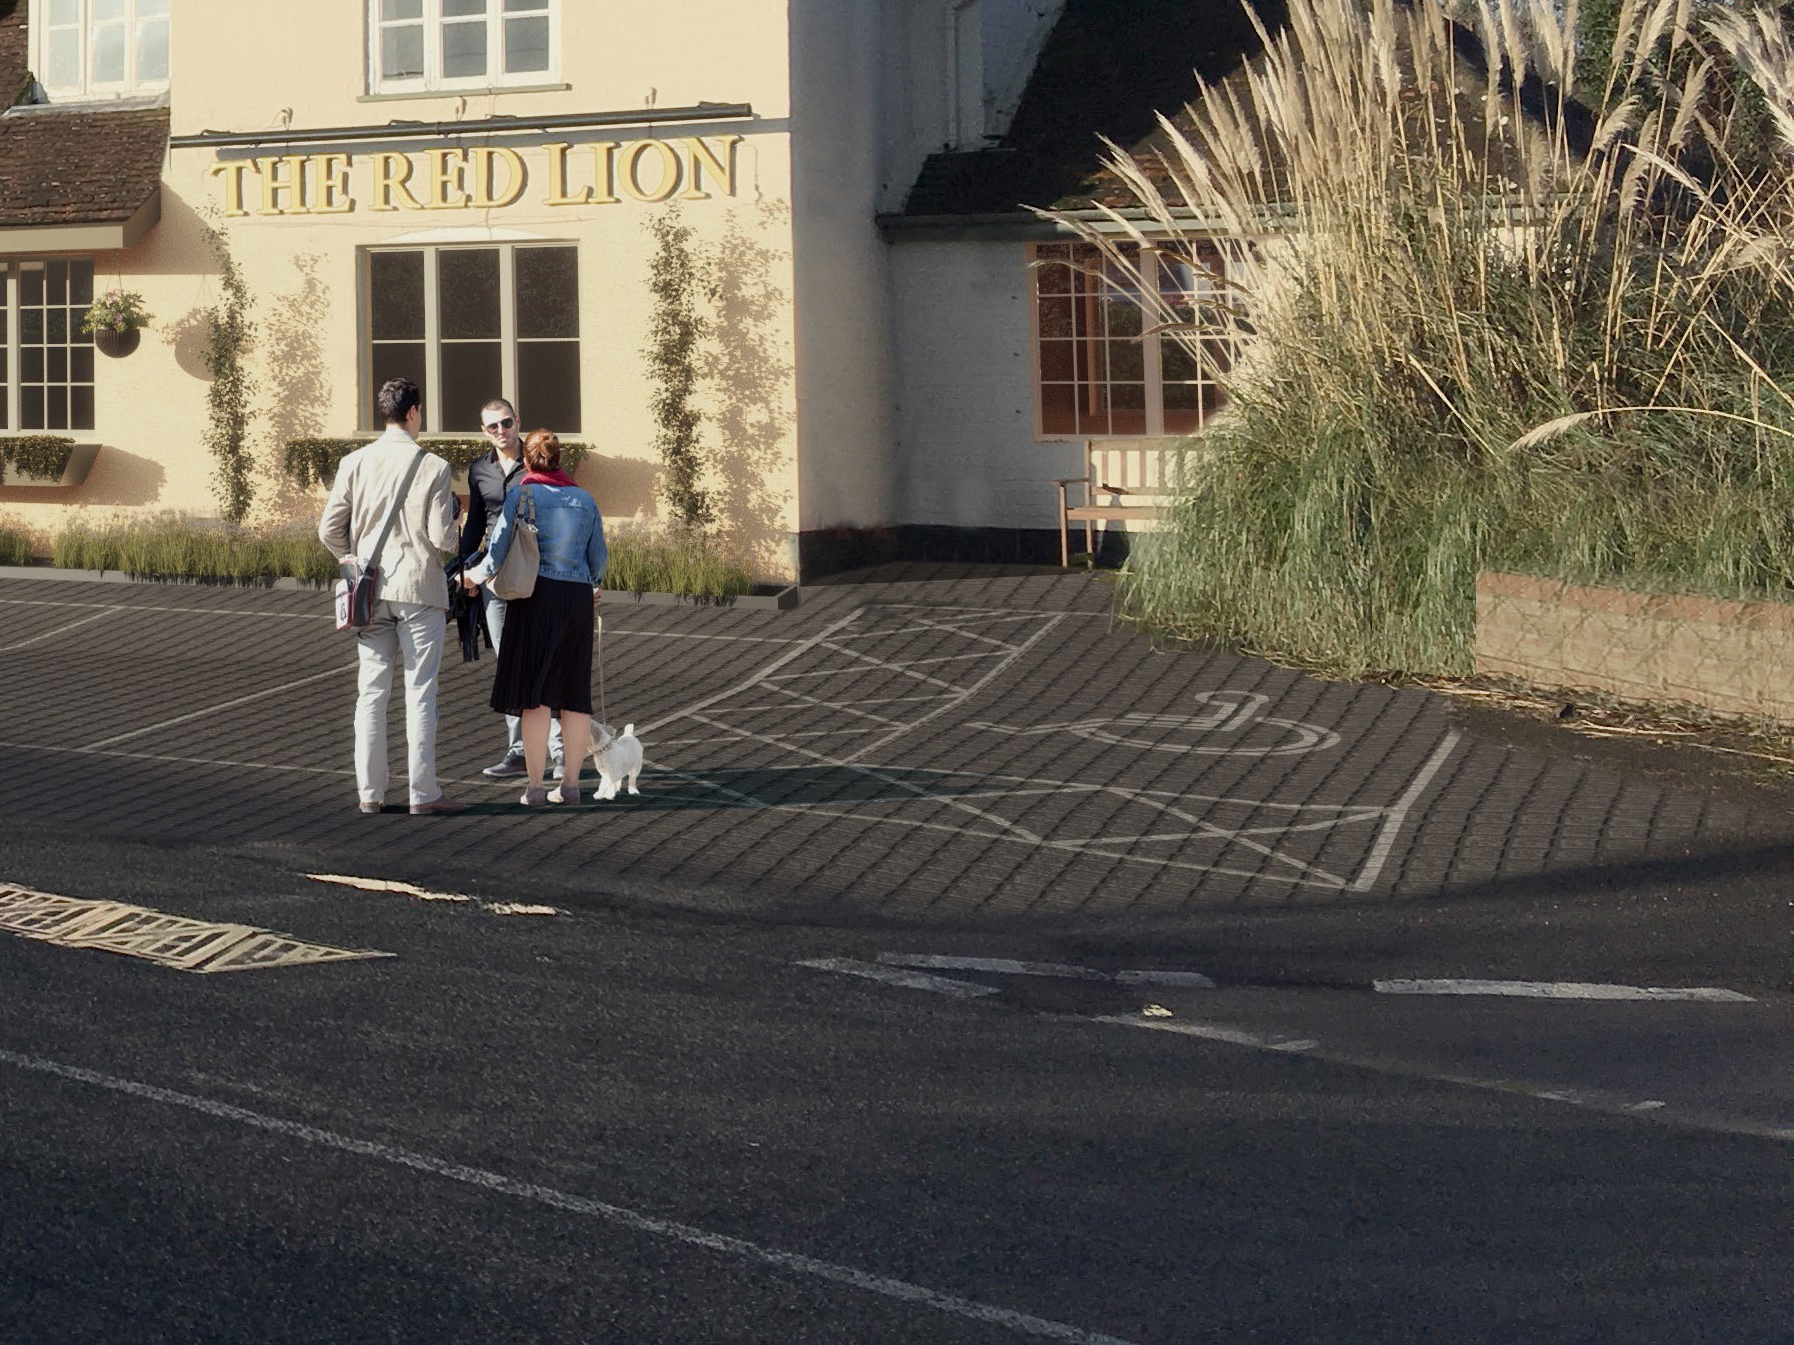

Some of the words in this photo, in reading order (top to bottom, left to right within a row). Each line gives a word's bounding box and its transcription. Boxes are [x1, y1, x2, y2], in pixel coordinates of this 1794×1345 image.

[209, 153, 353, 217] THE
[367, 147, 525, 211] RED
[541, 135, 739, 206] LION
